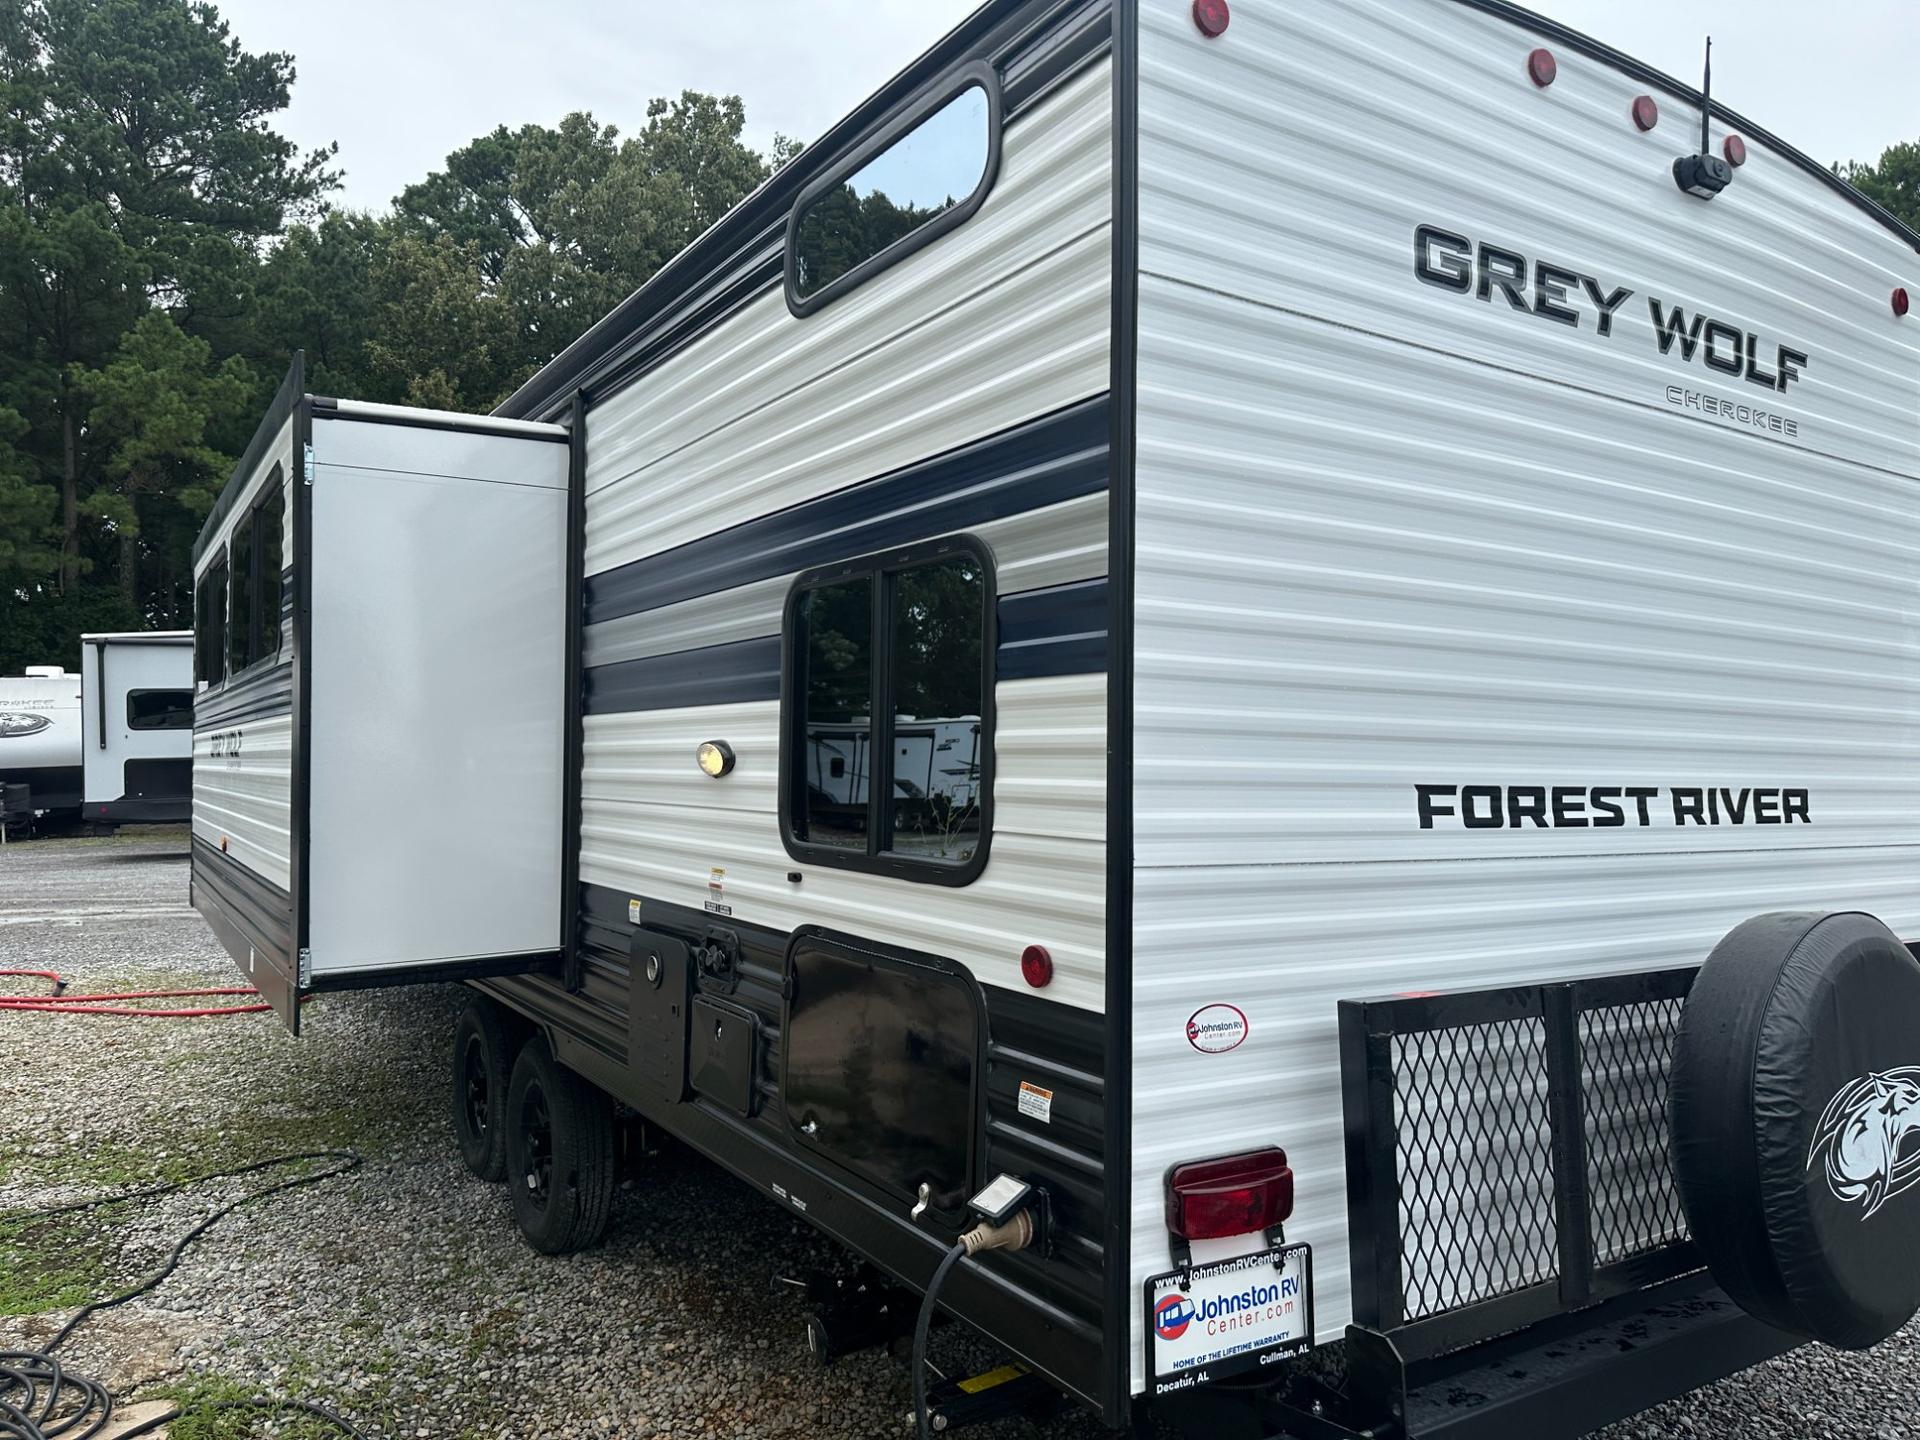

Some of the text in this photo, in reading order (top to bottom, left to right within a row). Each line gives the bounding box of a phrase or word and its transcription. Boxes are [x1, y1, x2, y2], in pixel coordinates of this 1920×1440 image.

[1414, 223, 1808, 394] GREY WOLF
[1666, 385, 1798, 437] CHEROKEE
[1414, 784, 1812, 829] FOREST RIVER
[1199, 1022, 1233, 1033] Johnston
[1155, 1246, 1307, 1289] www.JohnstonRVCente.com
[1196, 1274, 1299, 1322] Johnston RV
[1207, 1300, 1293, 1336] Center.com
[1173, 1331, 1289, 1369] HOME OF THE LIFETIME WARRANTY
[1260, 1344, 1309, 1365] Cullman, AL
[1156, 1371, 1209, 1394] Decatur, AL
